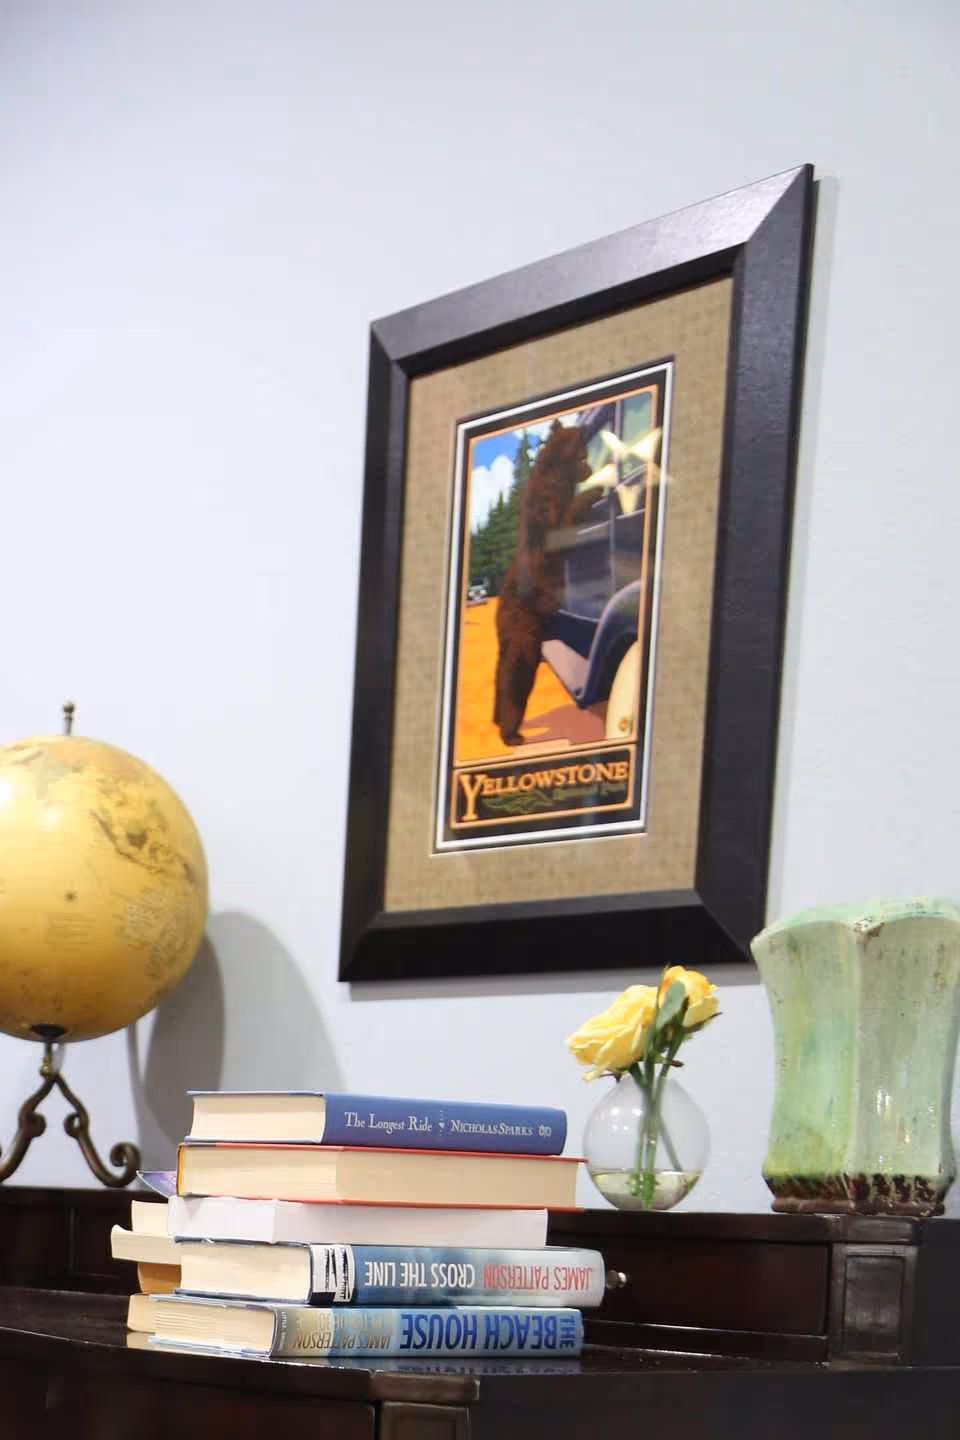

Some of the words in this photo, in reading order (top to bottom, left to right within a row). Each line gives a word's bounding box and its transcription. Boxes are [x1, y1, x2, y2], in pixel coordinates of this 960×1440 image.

[458, 761, 629, 821] YELLOWSTONE
[344, 1111, 366, 1128] The
[367, 1113, 406, 1135] Longest
[407, 1115, 433, 1132] Ride
[364, 1260, 396, 1287] LINE
[400, 1261, 427, 1288] THE
[430, 1261, 476, 1289] CROSS
[482, 1263, 550, 1291] PATTERSON
[551, 1264, 594, 1291] JAMES
[359, 1334, 392, 1350] JAMES
[399, 1313, 478, 1350] HOUSE
[484, 1314, 558, 1350] BEACH
[559, 1315, 577, 1349] THE
